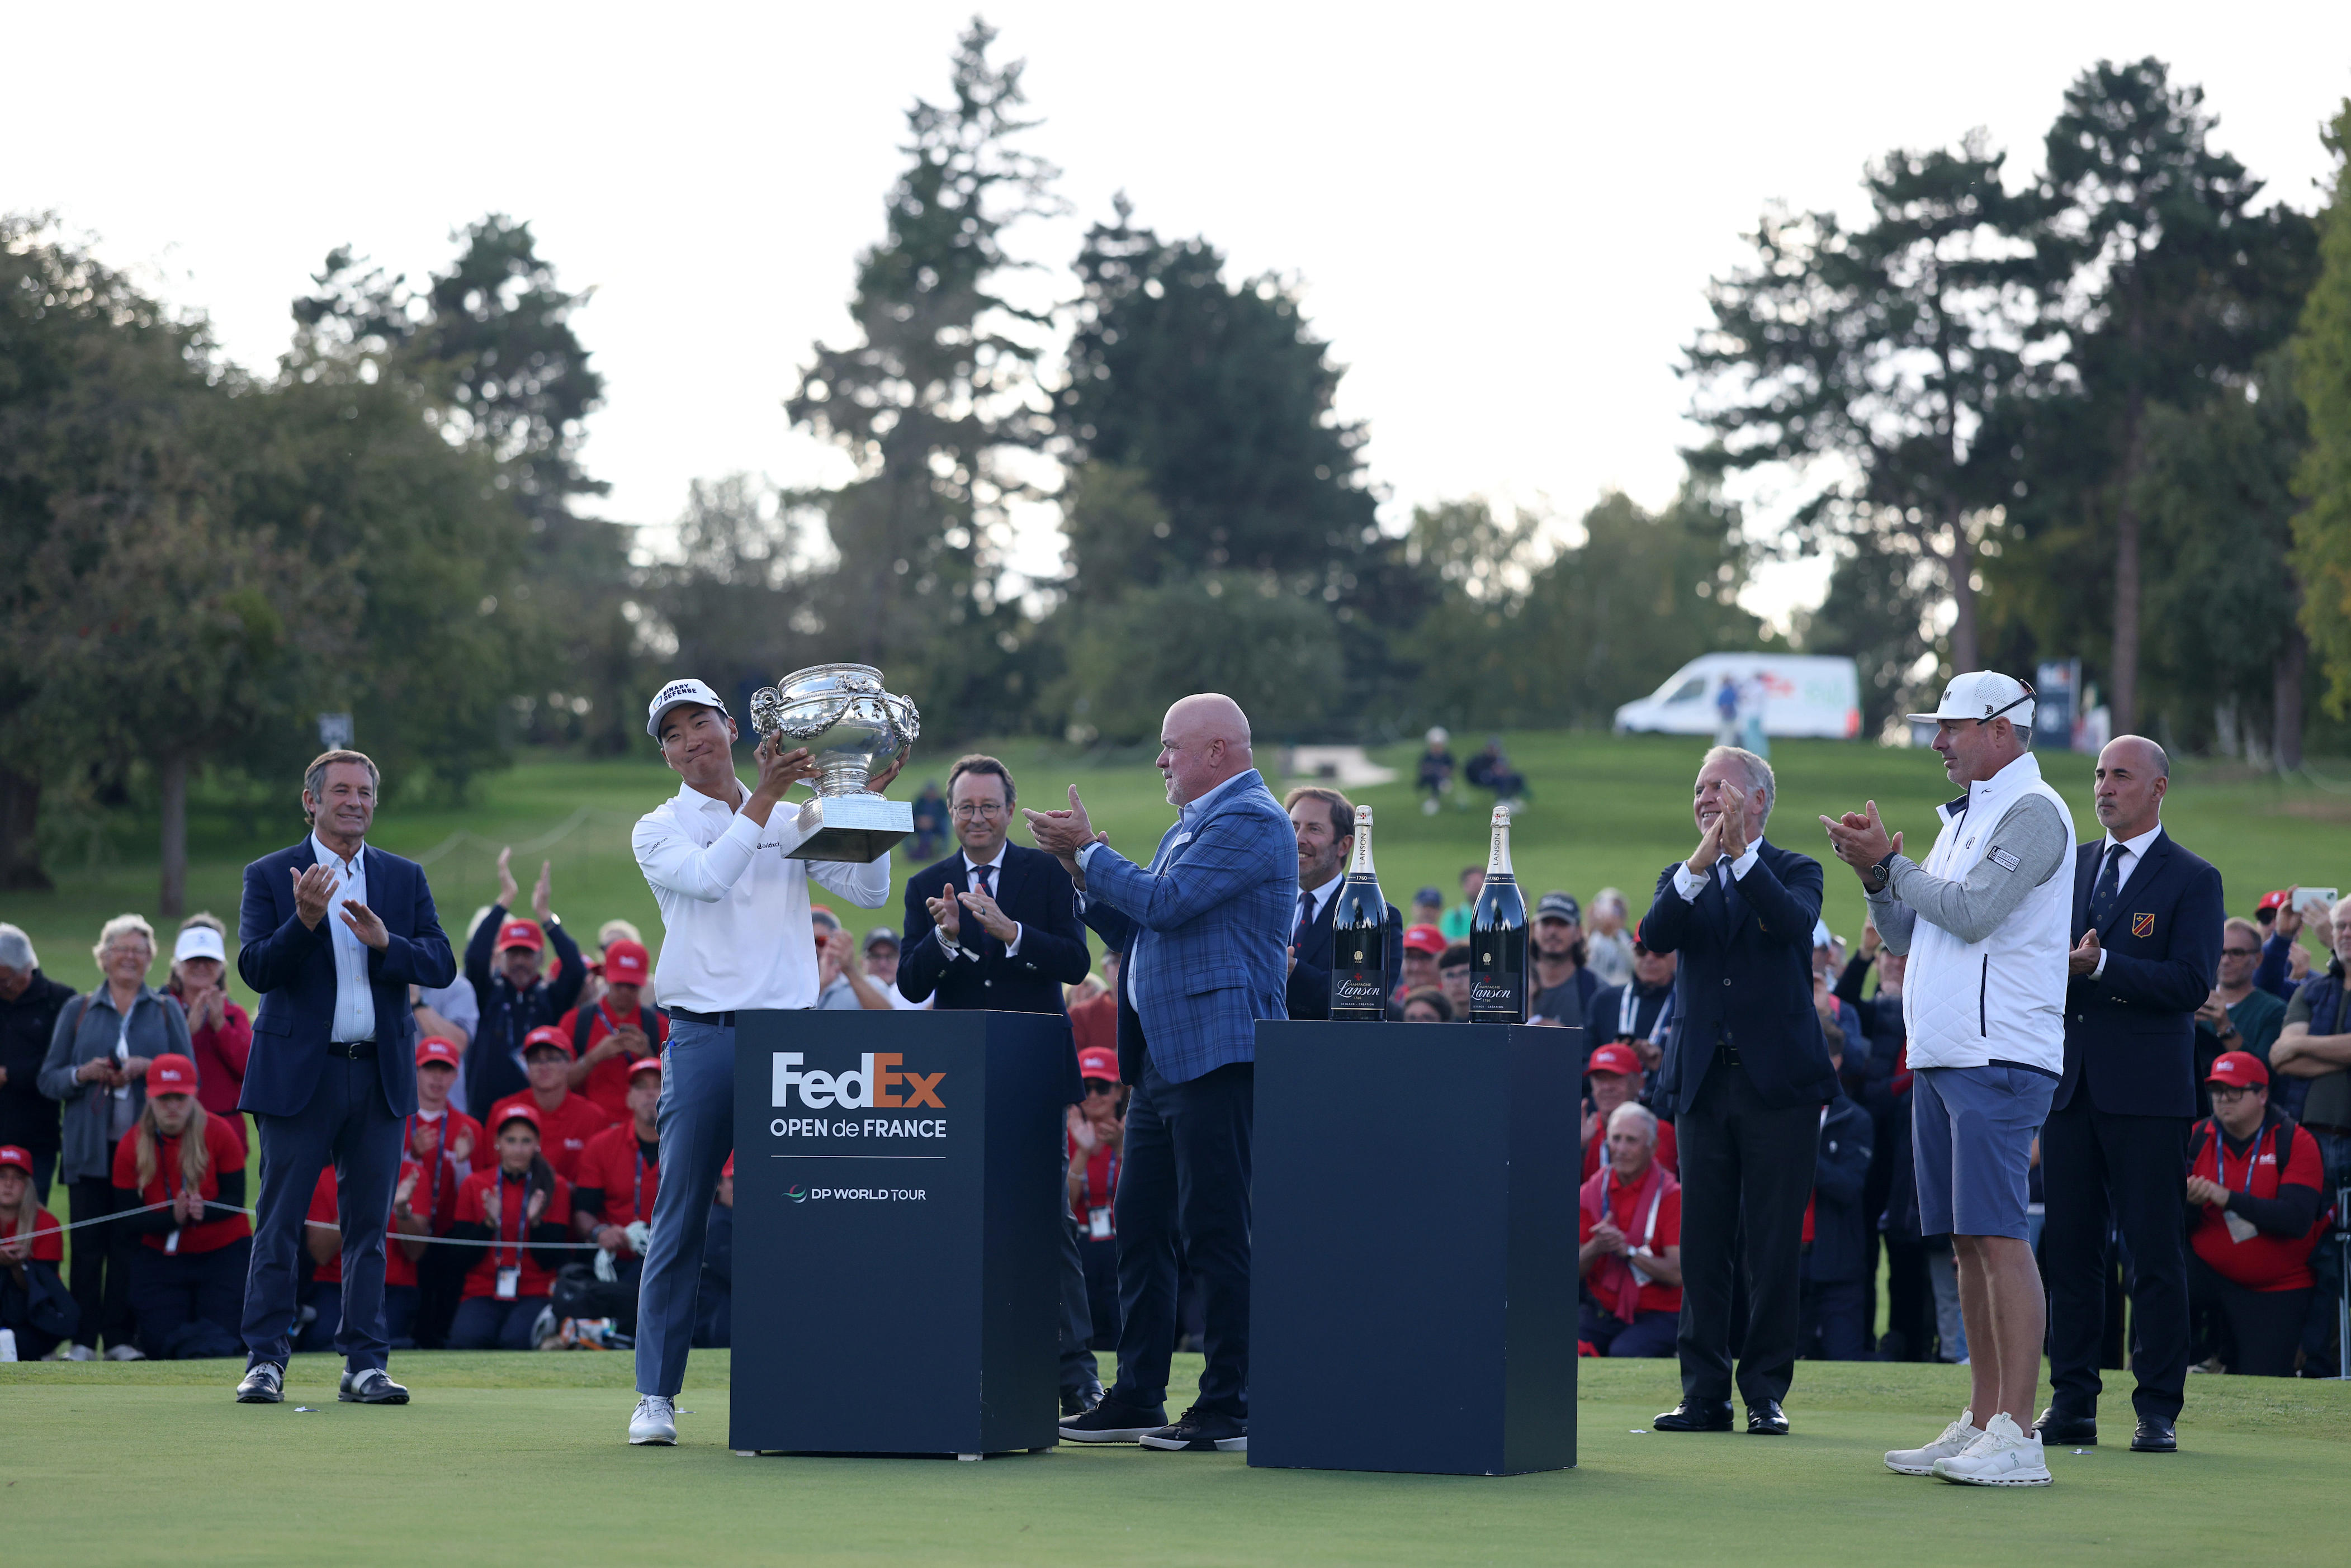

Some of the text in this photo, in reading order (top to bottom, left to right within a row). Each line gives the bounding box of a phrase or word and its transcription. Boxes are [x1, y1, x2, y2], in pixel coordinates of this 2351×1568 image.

[664, 684, 688, 697] BINARY
[664, 688, 697, 702] DEFENSE
[1999, 851, 2019, 865] HERITAGE
[1335, 979, 1380, 998] Lanson
[1470, 982, 1511, 1001] Lanson
[772, 1051, 947, 1110] FedEx
[770, 1118, 947, 1138] OPEN de FRANCE
[811, 1188, 926, 1202] DP WORLD TOUR
